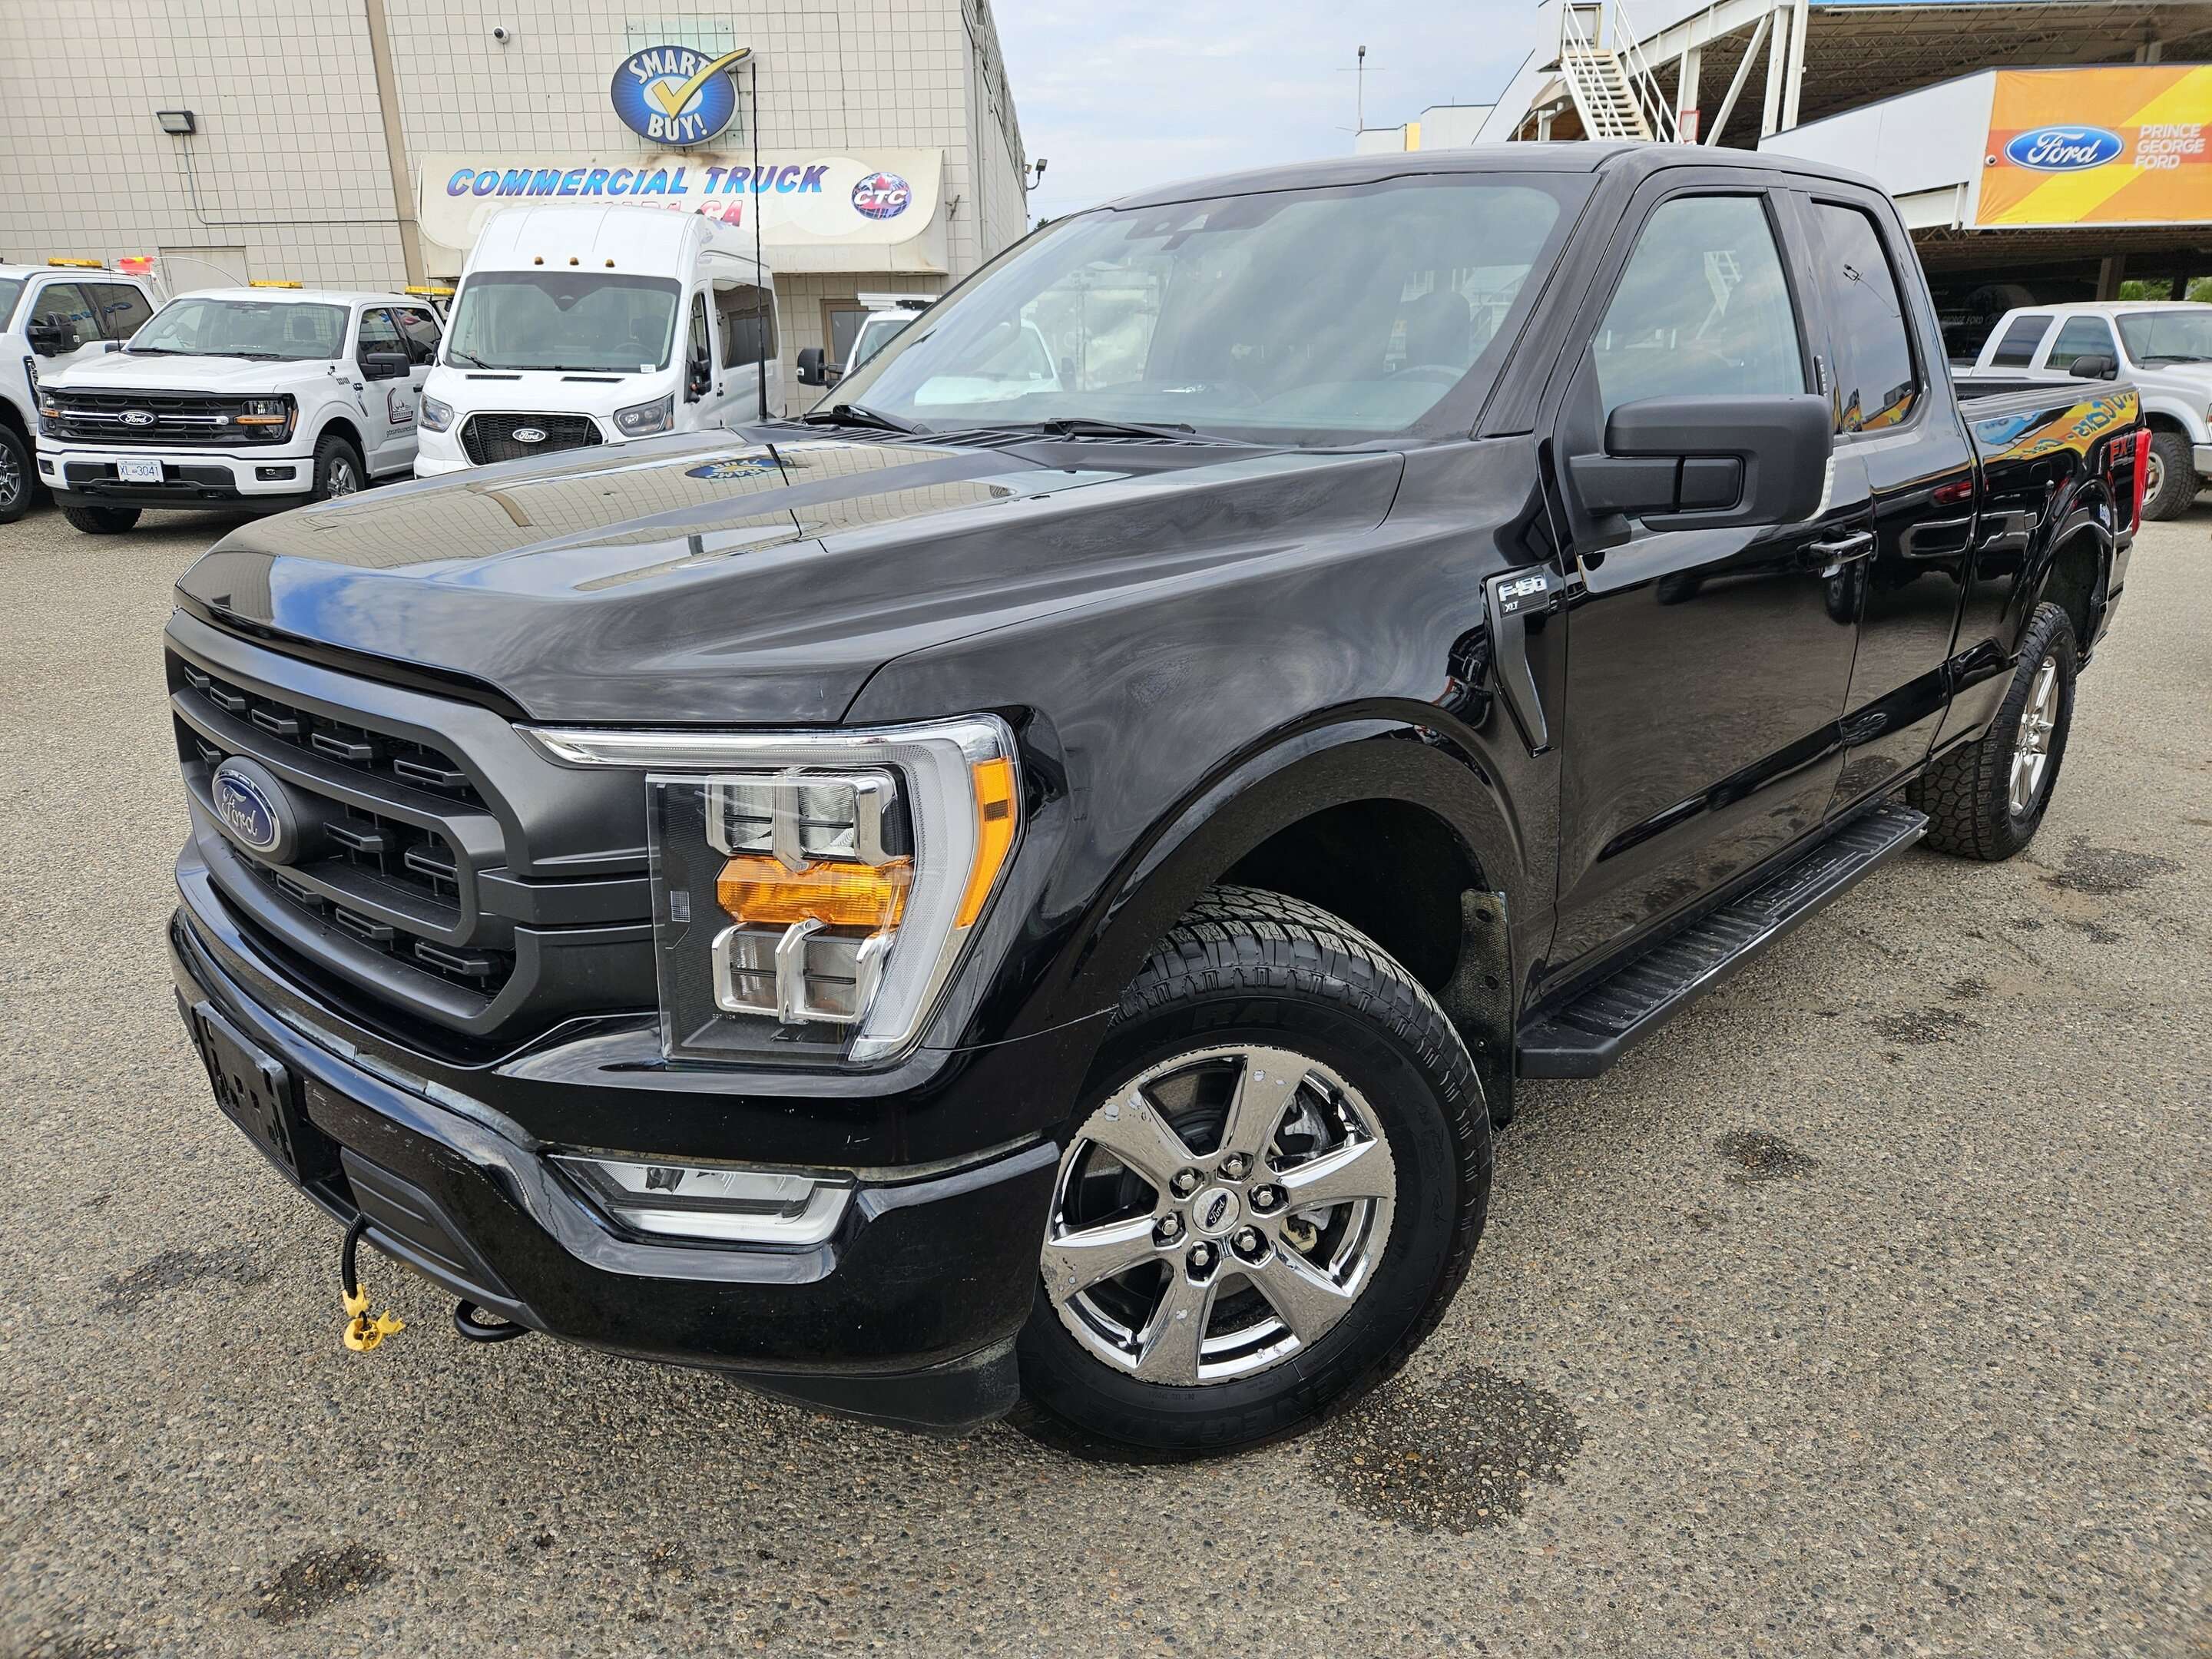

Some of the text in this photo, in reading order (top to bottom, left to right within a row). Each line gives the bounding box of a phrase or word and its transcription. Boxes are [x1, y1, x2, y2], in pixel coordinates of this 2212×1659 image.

[628, 49, 711, 85] SMART
[647, 113, 708, 141] BUY!
[2139, 123, 2202, 139] PRINCE
[2027, 131, 2102, 164] Ford
[2137, 138, 2207, 154] GEORGE
[2134, 154, 2181, 170] FORD
[446, 165, 830, 197] COMMERCIAL TRUCK
[853, 189, 909, 206] CTC
[125, 414, 147, 423] Ford
[518, 429, 540, 440] Ford
[1498, 575, 1548, 602] F-150
[1505, 601, 1518, 613] XLT
[221, 785, 258, 836] Ford
[1208, 1199, 1226, 1224] Ford
